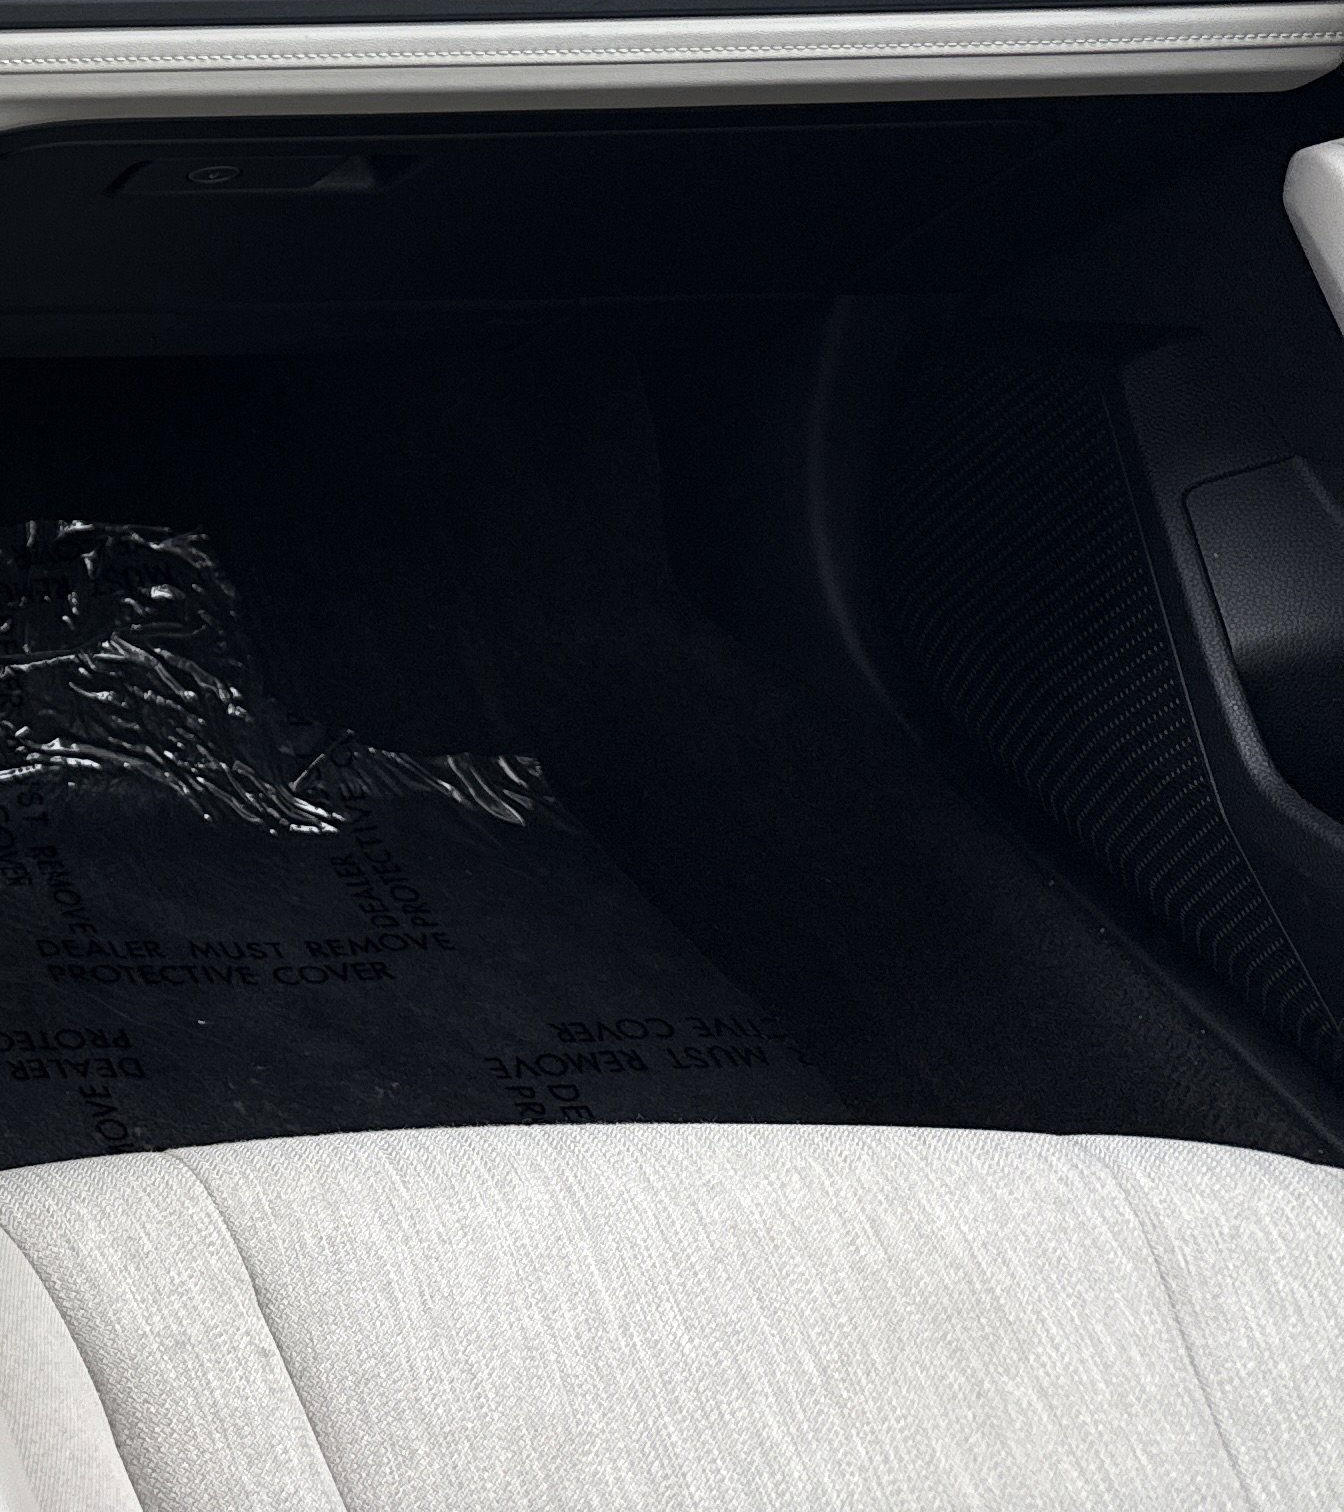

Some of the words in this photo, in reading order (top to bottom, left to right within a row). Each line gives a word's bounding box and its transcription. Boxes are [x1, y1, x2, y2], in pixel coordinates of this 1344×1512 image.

[329, 853, 400, 928] DEALER
[37, 937, 164, 961] DEALER
[190, 939, 284, 962] MUST
[307, 932, 456, 959] REMOVE
[48, 963, 259, 988] PROTECTIVE
[273, 961, 395, 986] COVER
[548, 1017, 674, 1044] COVER
[6, 1056, 147, 1082] DEALER
[484, 1048, 649, 1080] REMOVE
